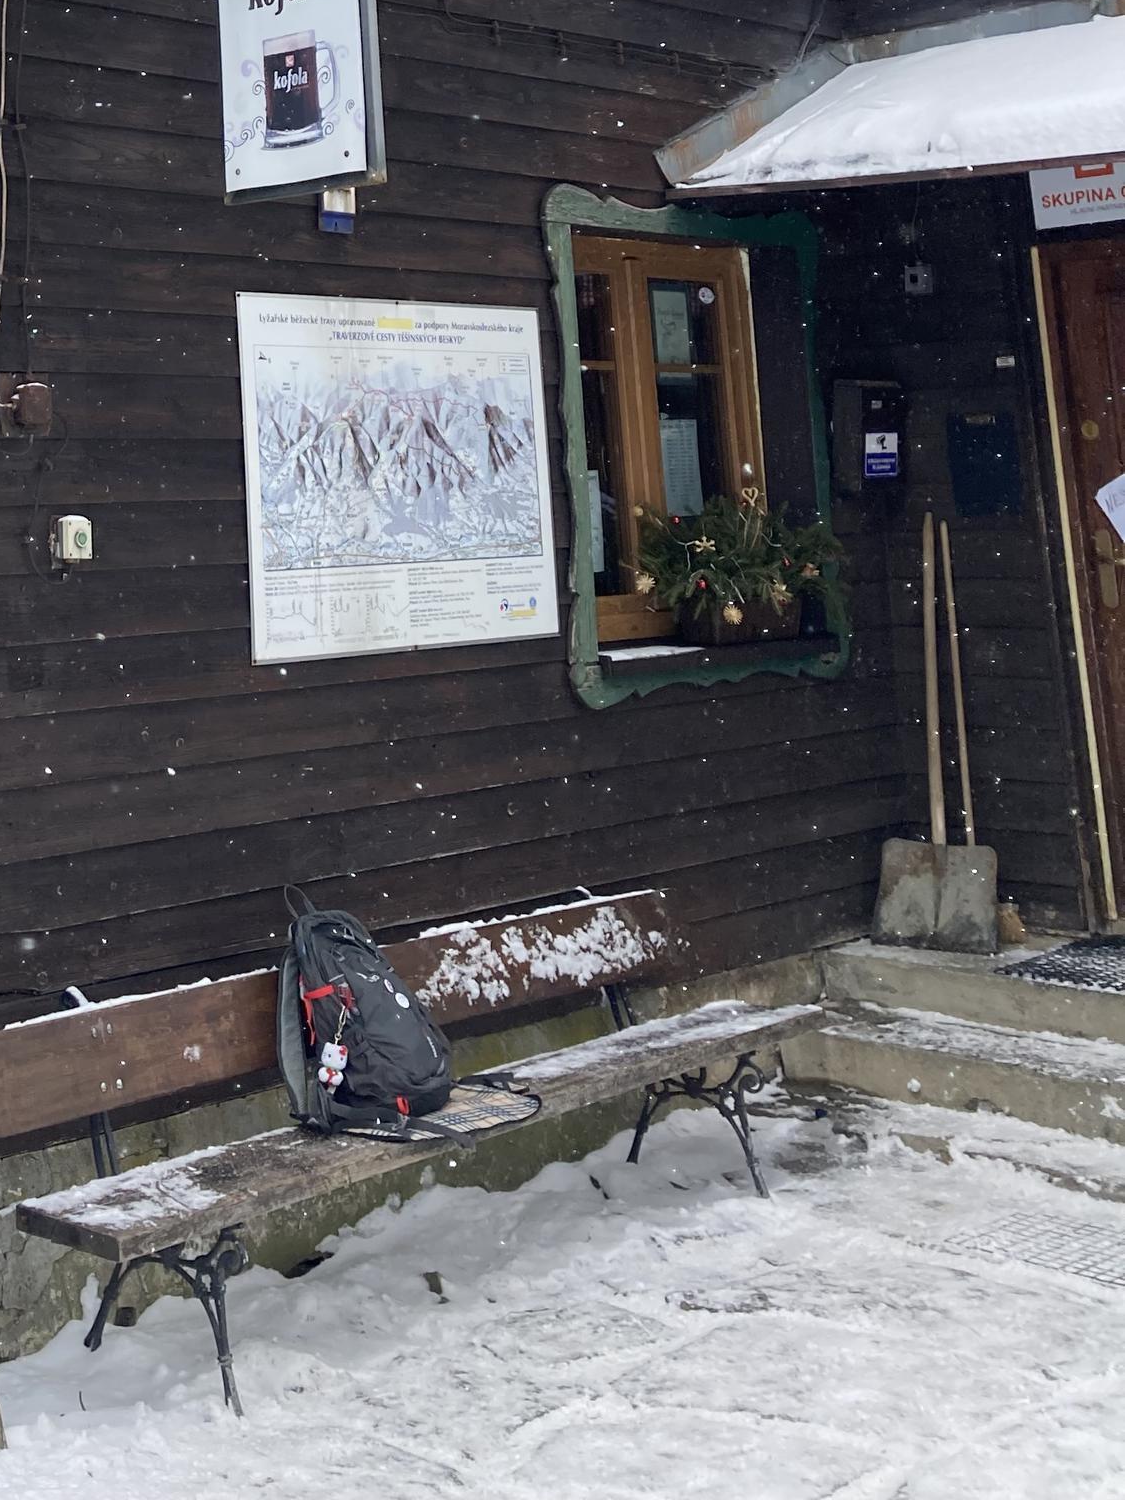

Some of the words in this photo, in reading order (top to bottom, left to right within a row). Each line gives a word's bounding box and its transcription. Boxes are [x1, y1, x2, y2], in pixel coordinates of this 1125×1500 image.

[273, 66, 308, 93] kofola
[1041, 187, 1117, 209] SKUPINA
[320, 317, 336, 327] trasy
[424, 320, 449, 331] podpory
[509, 324, 523, 334] kraje
